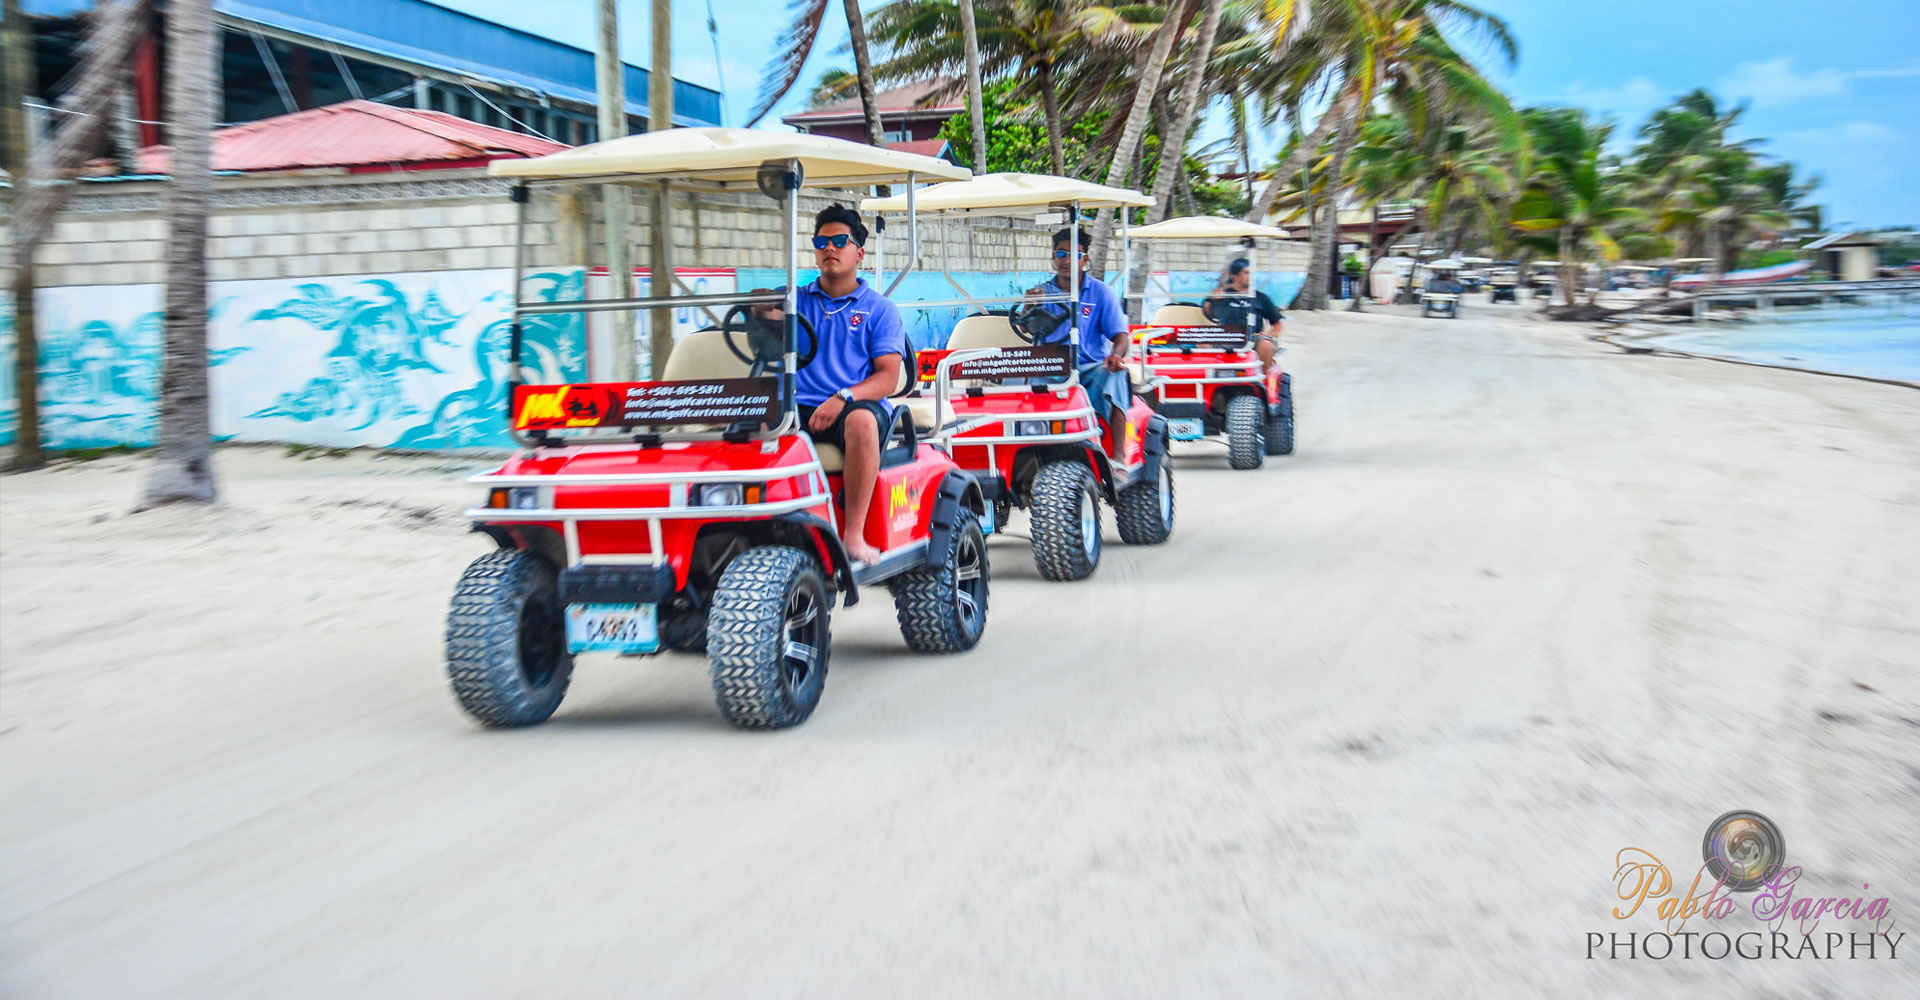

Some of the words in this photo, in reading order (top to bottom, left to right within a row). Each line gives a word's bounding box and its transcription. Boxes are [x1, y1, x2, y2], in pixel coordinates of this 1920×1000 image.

[962, 365, 1063, 375] www.mkgolfcartrental.com
[516, 385, 571, 428] MK
[624, 396, 770, 409] info@mkgolfcartrental.com
[624, 407, 767, 420] www.mkgolfcartrental.com
